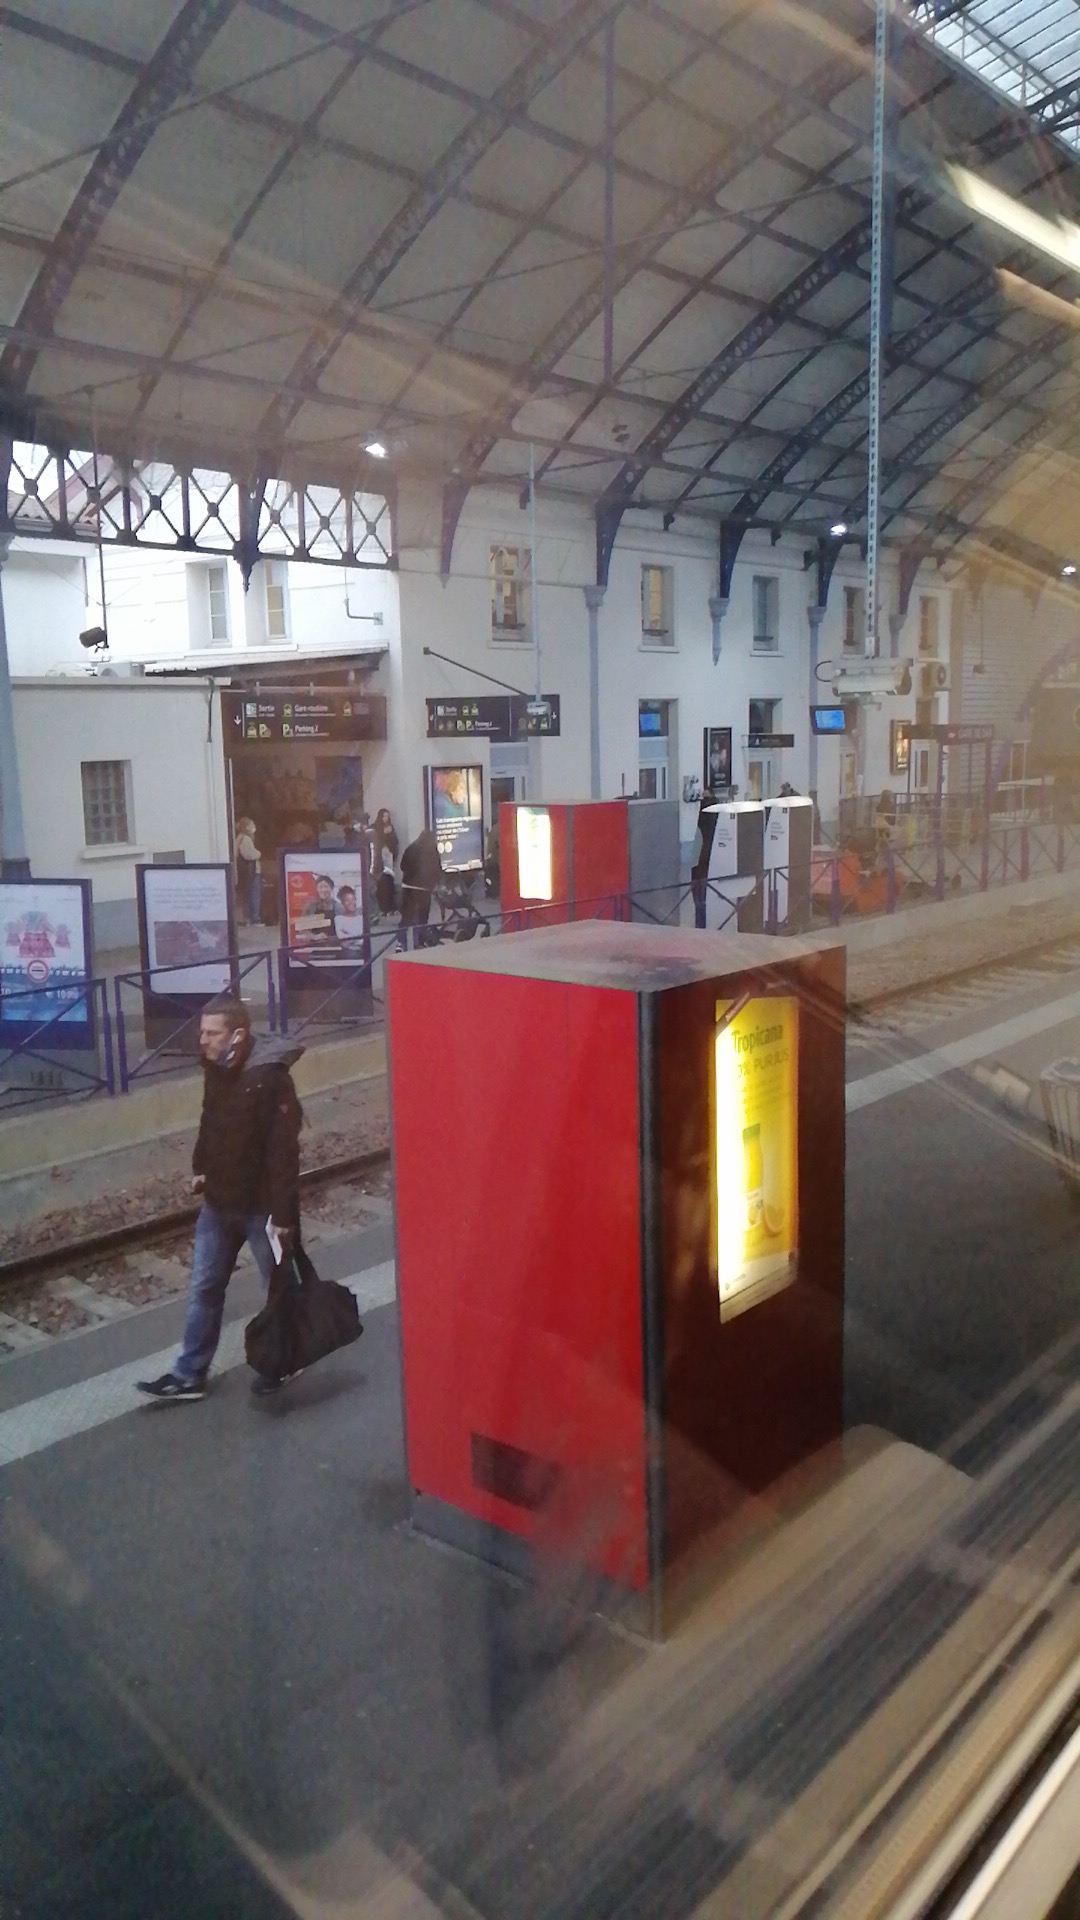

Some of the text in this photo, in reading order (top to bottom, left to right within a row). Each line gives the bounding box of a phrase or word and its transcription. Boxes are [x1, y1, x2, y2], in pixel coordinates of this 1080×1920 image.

[258, 704, 275, 713] Sortie
[294, 704, 308, 713] Gare
[294, 725, 314, 733] Parking
[731, 1024, 784, 1054] Tropicana
